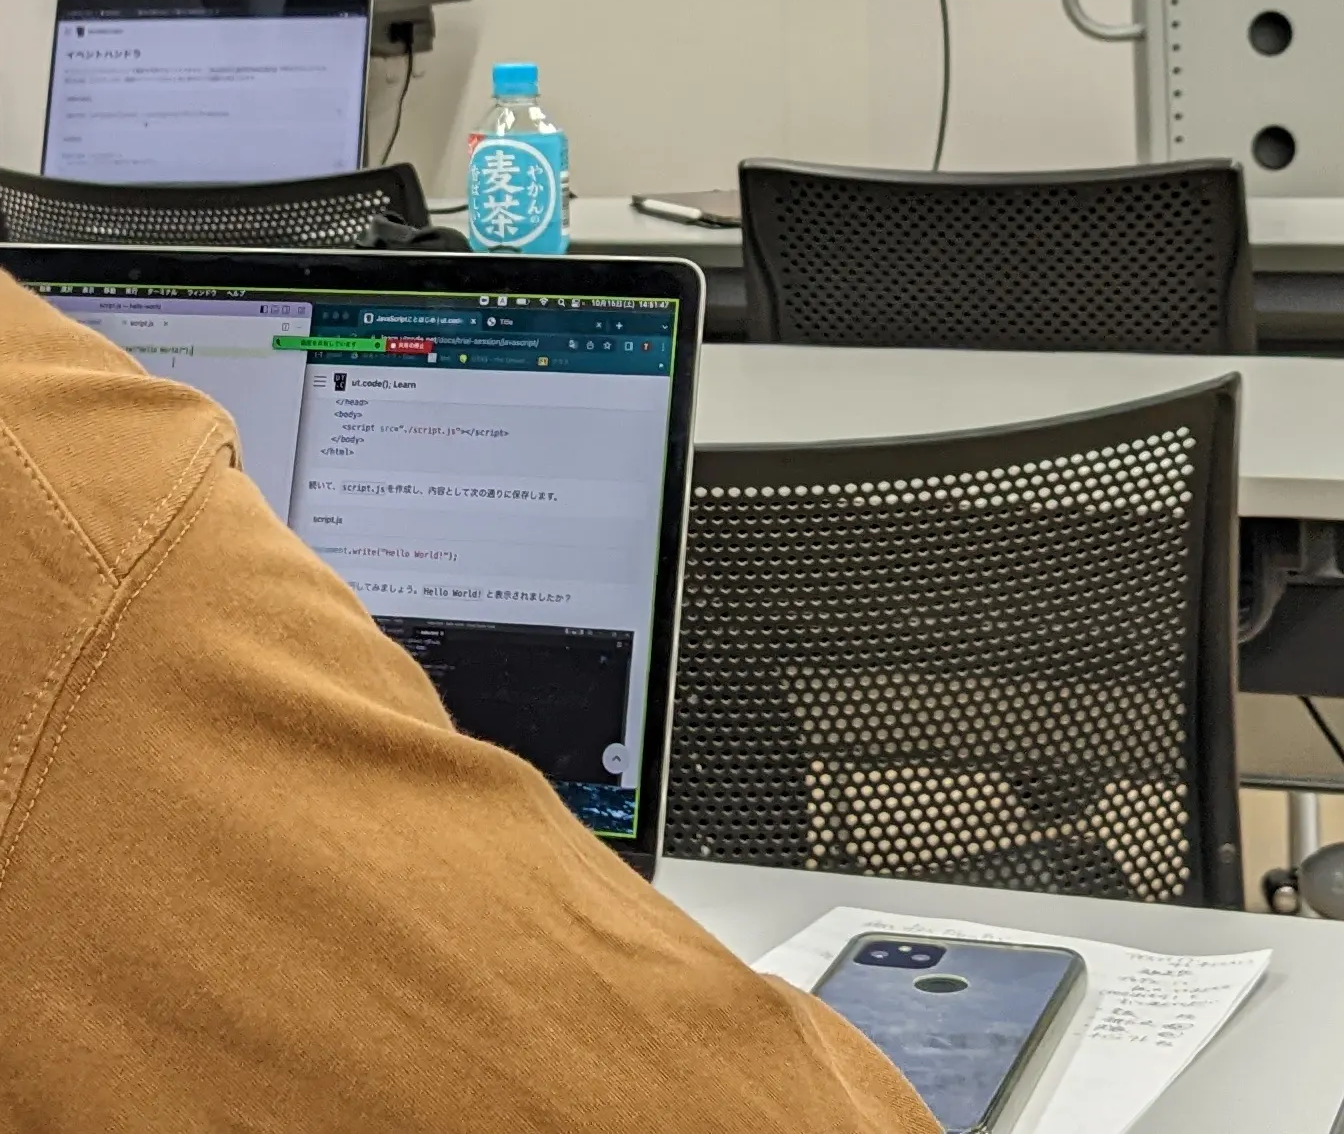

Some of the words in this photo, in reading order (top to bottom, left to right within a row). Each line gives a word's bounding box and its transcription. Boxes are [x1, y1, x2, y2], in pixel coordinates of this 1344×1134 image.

[481, 149, 526, 239] 麦茶
[526, 164, 544, 224] やかんの
[226, 288, 246, 298] ヘルプ
[351, 379, 391, 390] ut.code();
[393, 380, 416, 389] Learn
[335, 398, 369, 406] </head>
[333, 411, 363, 420] <body>
[342, 423, 375, 433] <script
[330, 435, 365, 445] </body>
[320, 447, 355, 456] </html>
[342, 483, 385, 495] script.js
[312, 515, 343, 525] script.js
[423, 586, 449, 597] Hello
[452, 588, 482, 600] World!
